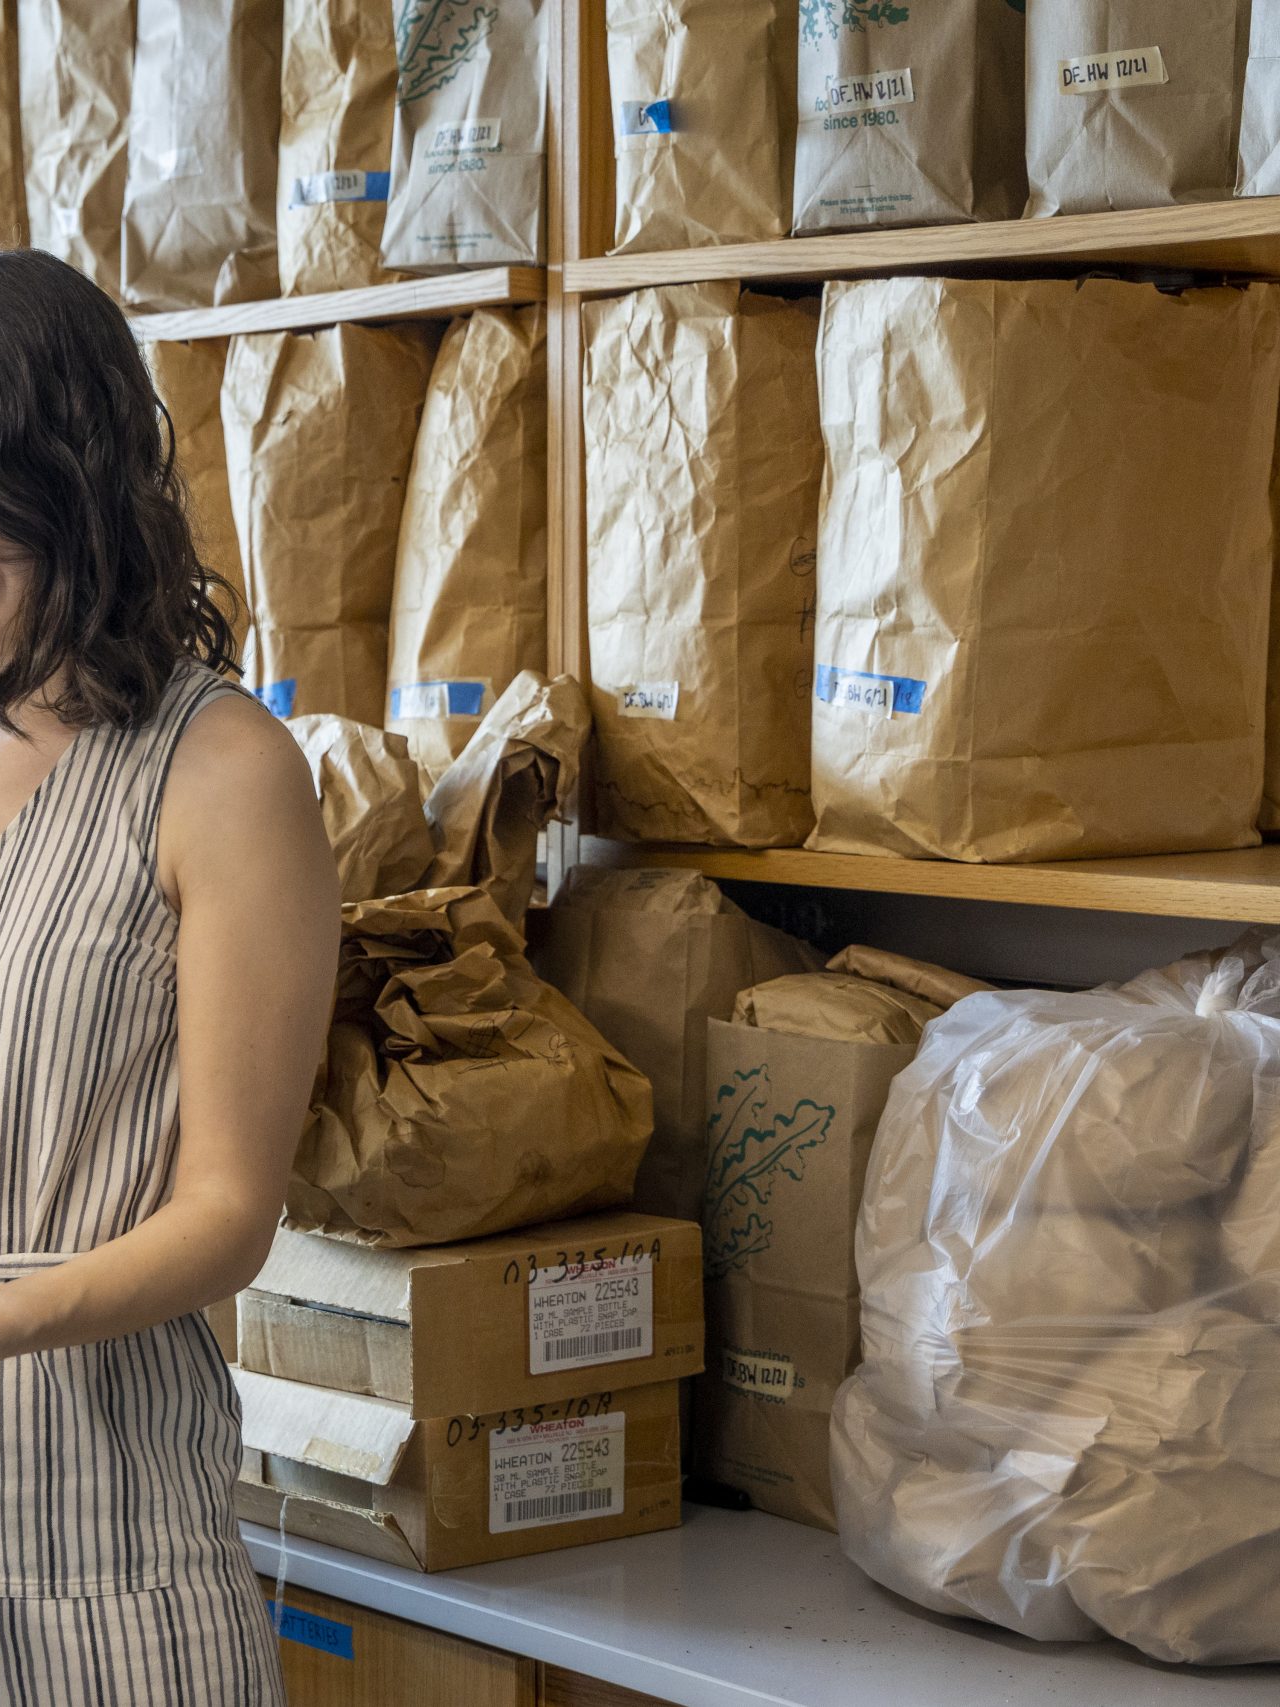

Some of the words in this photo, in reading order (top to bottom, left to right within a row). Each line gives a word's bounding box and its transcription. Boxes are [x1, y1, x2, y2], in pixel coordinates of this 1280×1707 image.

[1116, 57, 1148, 78] 12/21
[875, 76, 906, 100] 12/21
[823, 114, 859, 131] since
[861, 109, 900, 127] 1980.
[533, 1291, 587, 1309] WHEATON
[594, 1276, 639, 1301] 225543
[533, 1320, 554, 1331] WITH
[558, 1313, 594, 1327] PLASTIC
[597, 1310, 618, 1321] SNAP
[548, 1310, 559, 1320] ML
[563, 1304, 593, 1317] SAMPLE
[597, 1300, 628, 1313] BOTTLE
[543, 1327, 565, 1339] CASE
[580, 1323, 591, 1333] 72
[594, 1318, 626, 1331] PIECES
[529, 1418, 586, 1435] WHEATON
[494, 1451, 553, 1471] WHEATON
[561, 1437, 610, 1463] 225543
[493, 1481, 516, 1493] WITH
[520, 1475, 560, 1488] PLASTIC
[564, 1470, 586, 1482] SNAP
[509, 1471, 521, 1481] ML
[526, 1465, 560, 1479] SAMPLE
[564, 1460, 597, 1473] BOTTLE
[504, 1488, 527, 1500] CASE
[544, 1484, 556, 1495] 72
[560, 1478, 595, 1491] PIECES
[278, 1611, 339, 1647] ATTERIES
